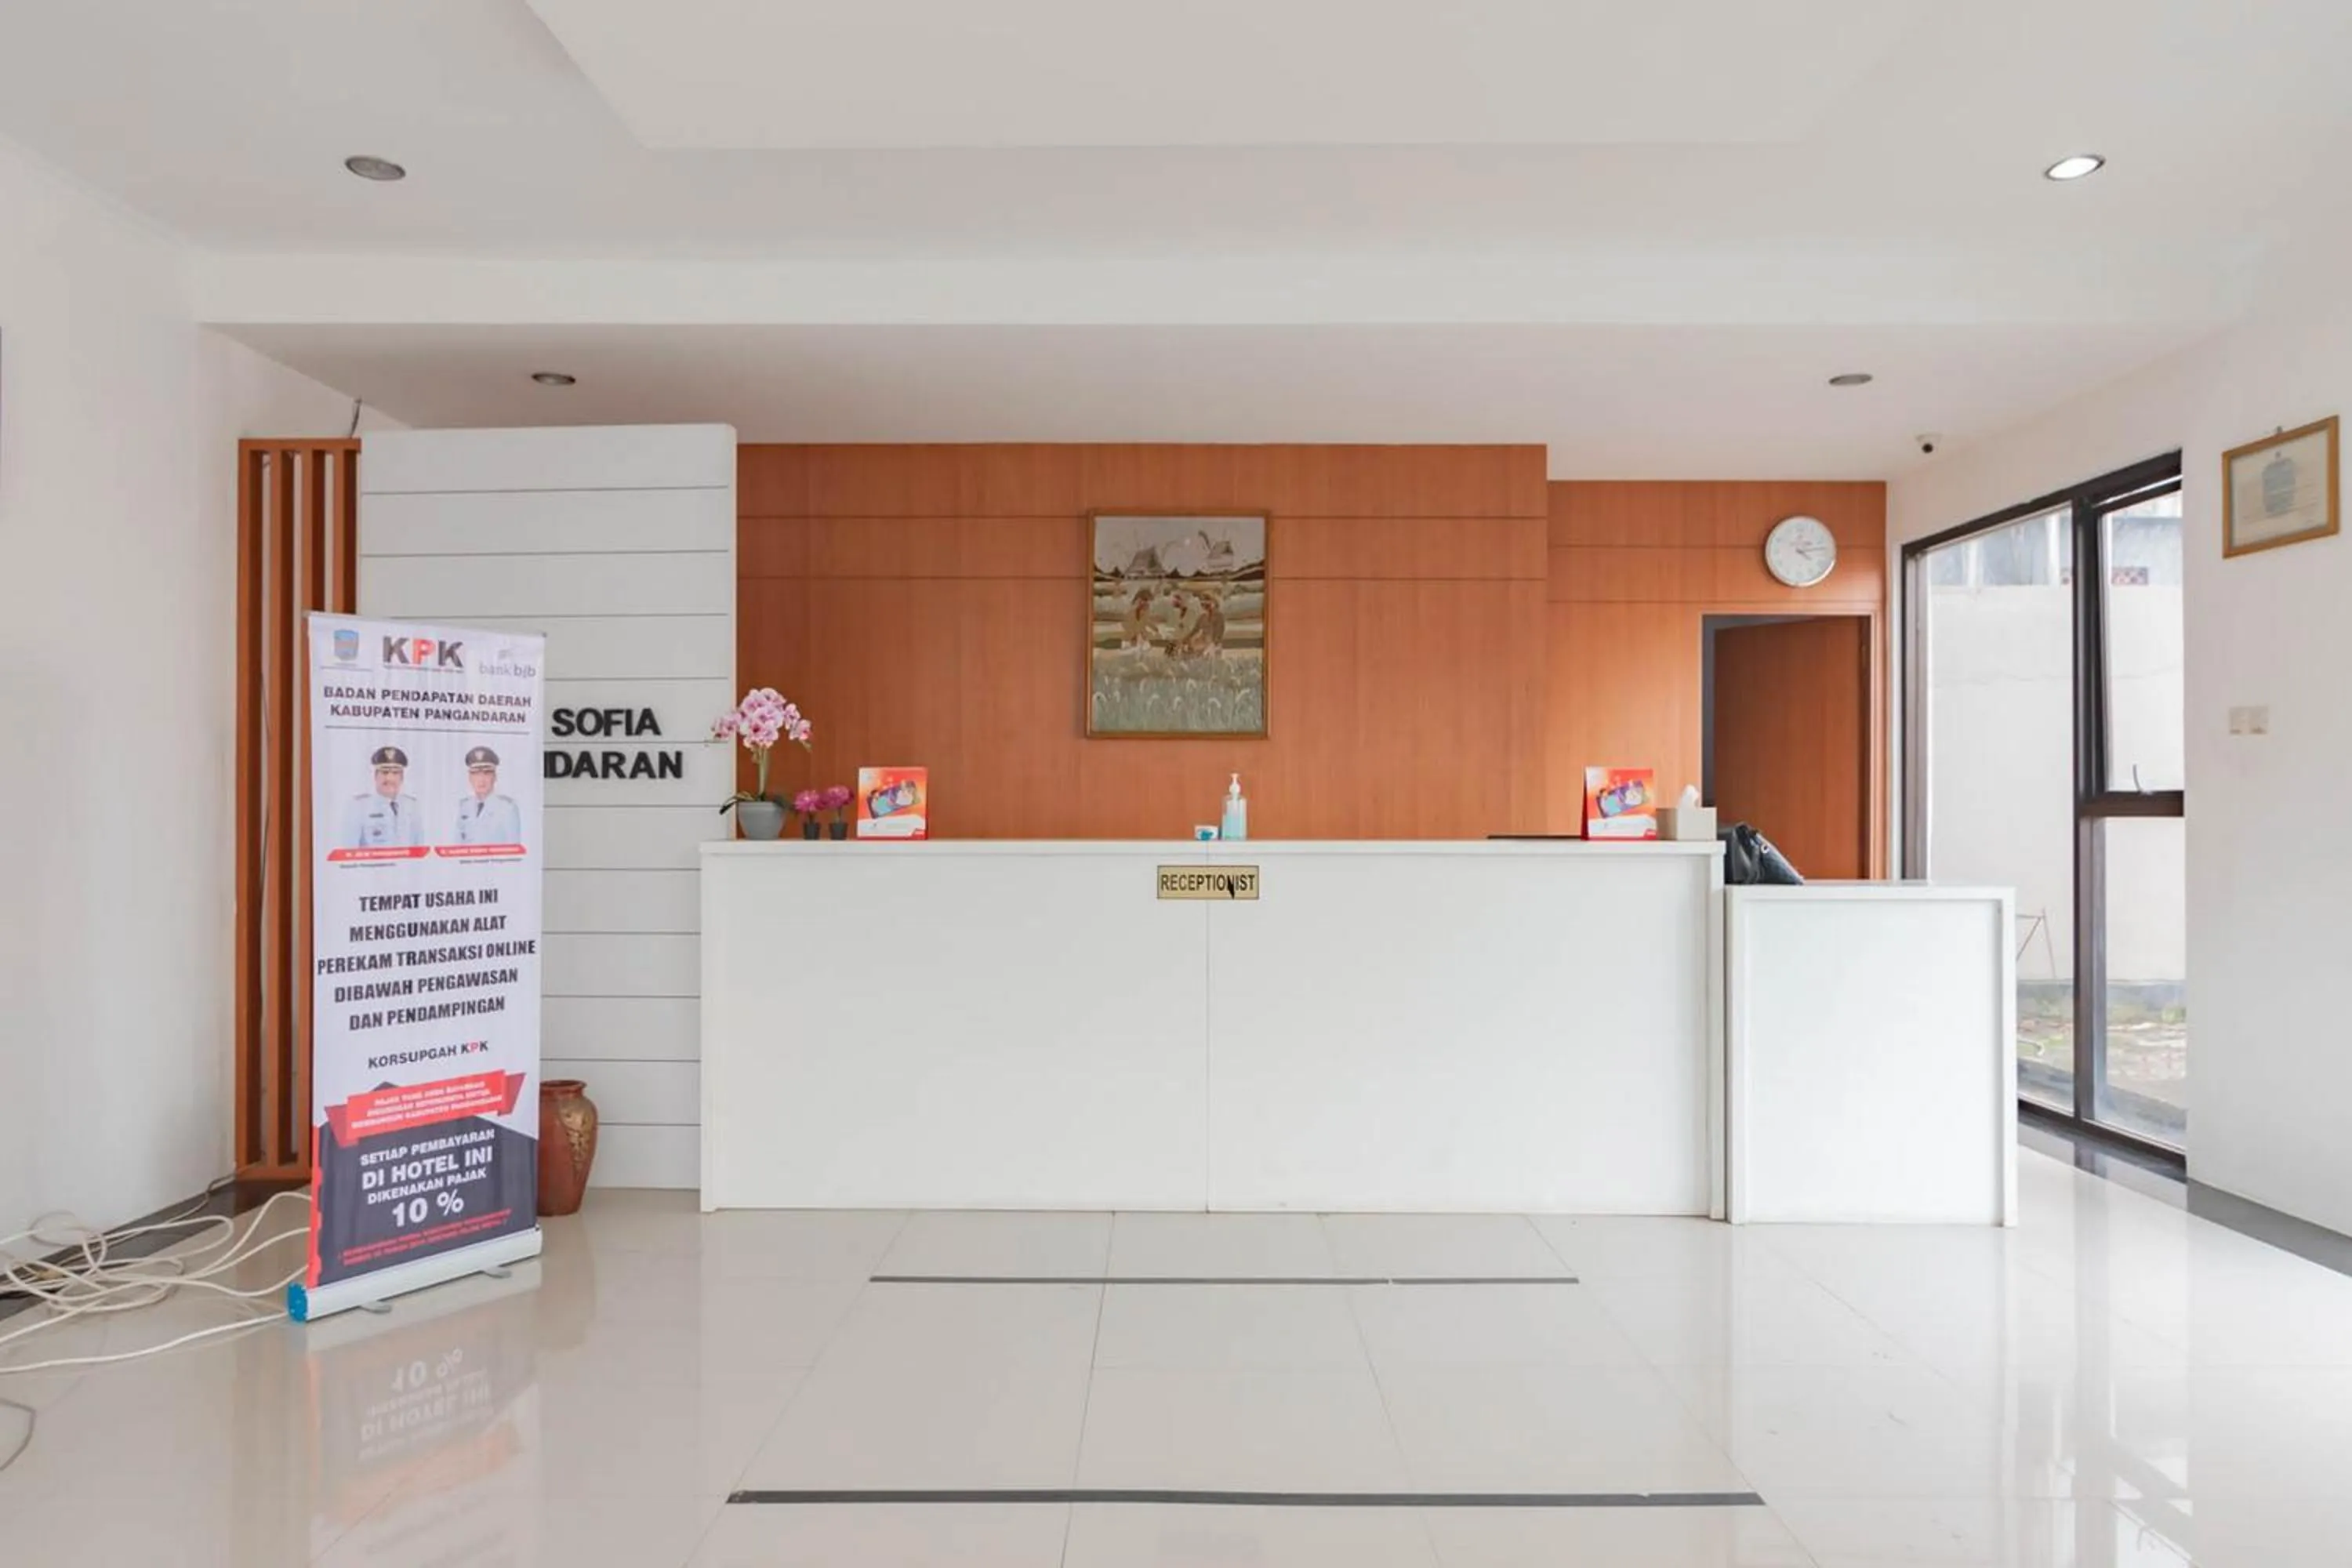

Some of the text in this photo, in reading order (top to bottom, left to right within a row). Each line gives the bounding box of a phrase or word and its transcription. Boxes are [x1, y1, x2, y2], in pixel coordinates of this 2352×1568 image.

[383, 636, 463, 668] KPK
[514, 663, 536, 678] bjb
[324, 685, 531, 707] BADAN PENDAPATAN DAERAH
[331, 704, 525, 723] KABUPATEN PANGANDARAN
[551, 708, 662, 736] SOFIA
[543, 750, 683, 779] DARAN
[1160, 874, 1254, 891] RECEPTIONIST
[359, 889, 499, 912] TEMPAT USAHA INI
[350, 915, 507, 942] MENGGUNAKAN ALAT
[318, 940, 536, 975] PEREKAM TRANSAKSI ONLINE
[335, 968, 518, 1003] DIBAWAH PENGAWASAN
[350, 996, 505, 1031] DAN PENDAMPINGAN
[368, 1040, 488, 1069] KORSUPGAH KPK
[360, 1129, 495, 1166] SETIAP PEMBAYARAN
[362, 1145, 492, 1189] DI HOTEL INI
[368, 1167, 487, 1204] DIKENAKAN PAJAK
[392, 1189, 464, 1227] 10 %
